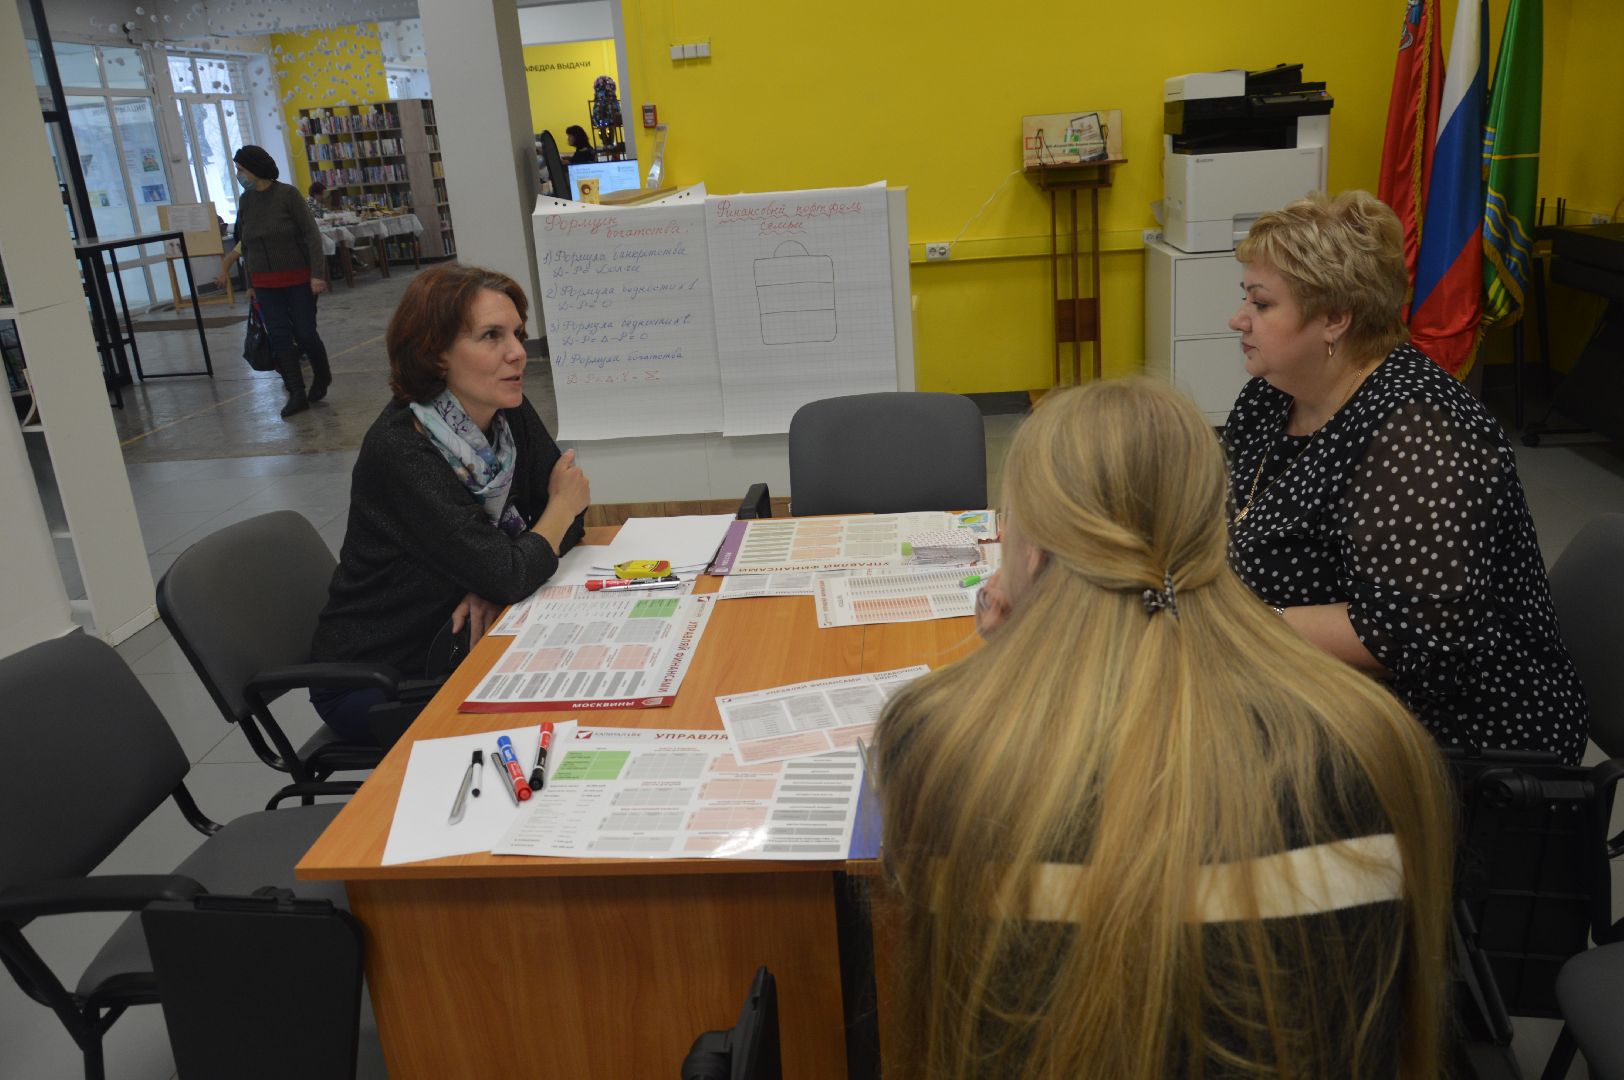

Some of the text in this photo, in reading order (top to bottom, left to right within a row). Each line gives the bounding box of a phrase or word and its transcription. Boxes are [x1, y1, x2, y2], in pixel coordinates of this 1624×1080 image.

[557, 61, 591, 70] ВЫДАЧИ
[737, 564, 819, 573] ФИНАНСАМИ
[657, 621, 698, 693] УПРАВЛЯЙ ФИНАНСАМИ
[572, 701, 635, 709] МОСКВИНЫ
[655, 733, 729, 741] УПРАВЛЯ
